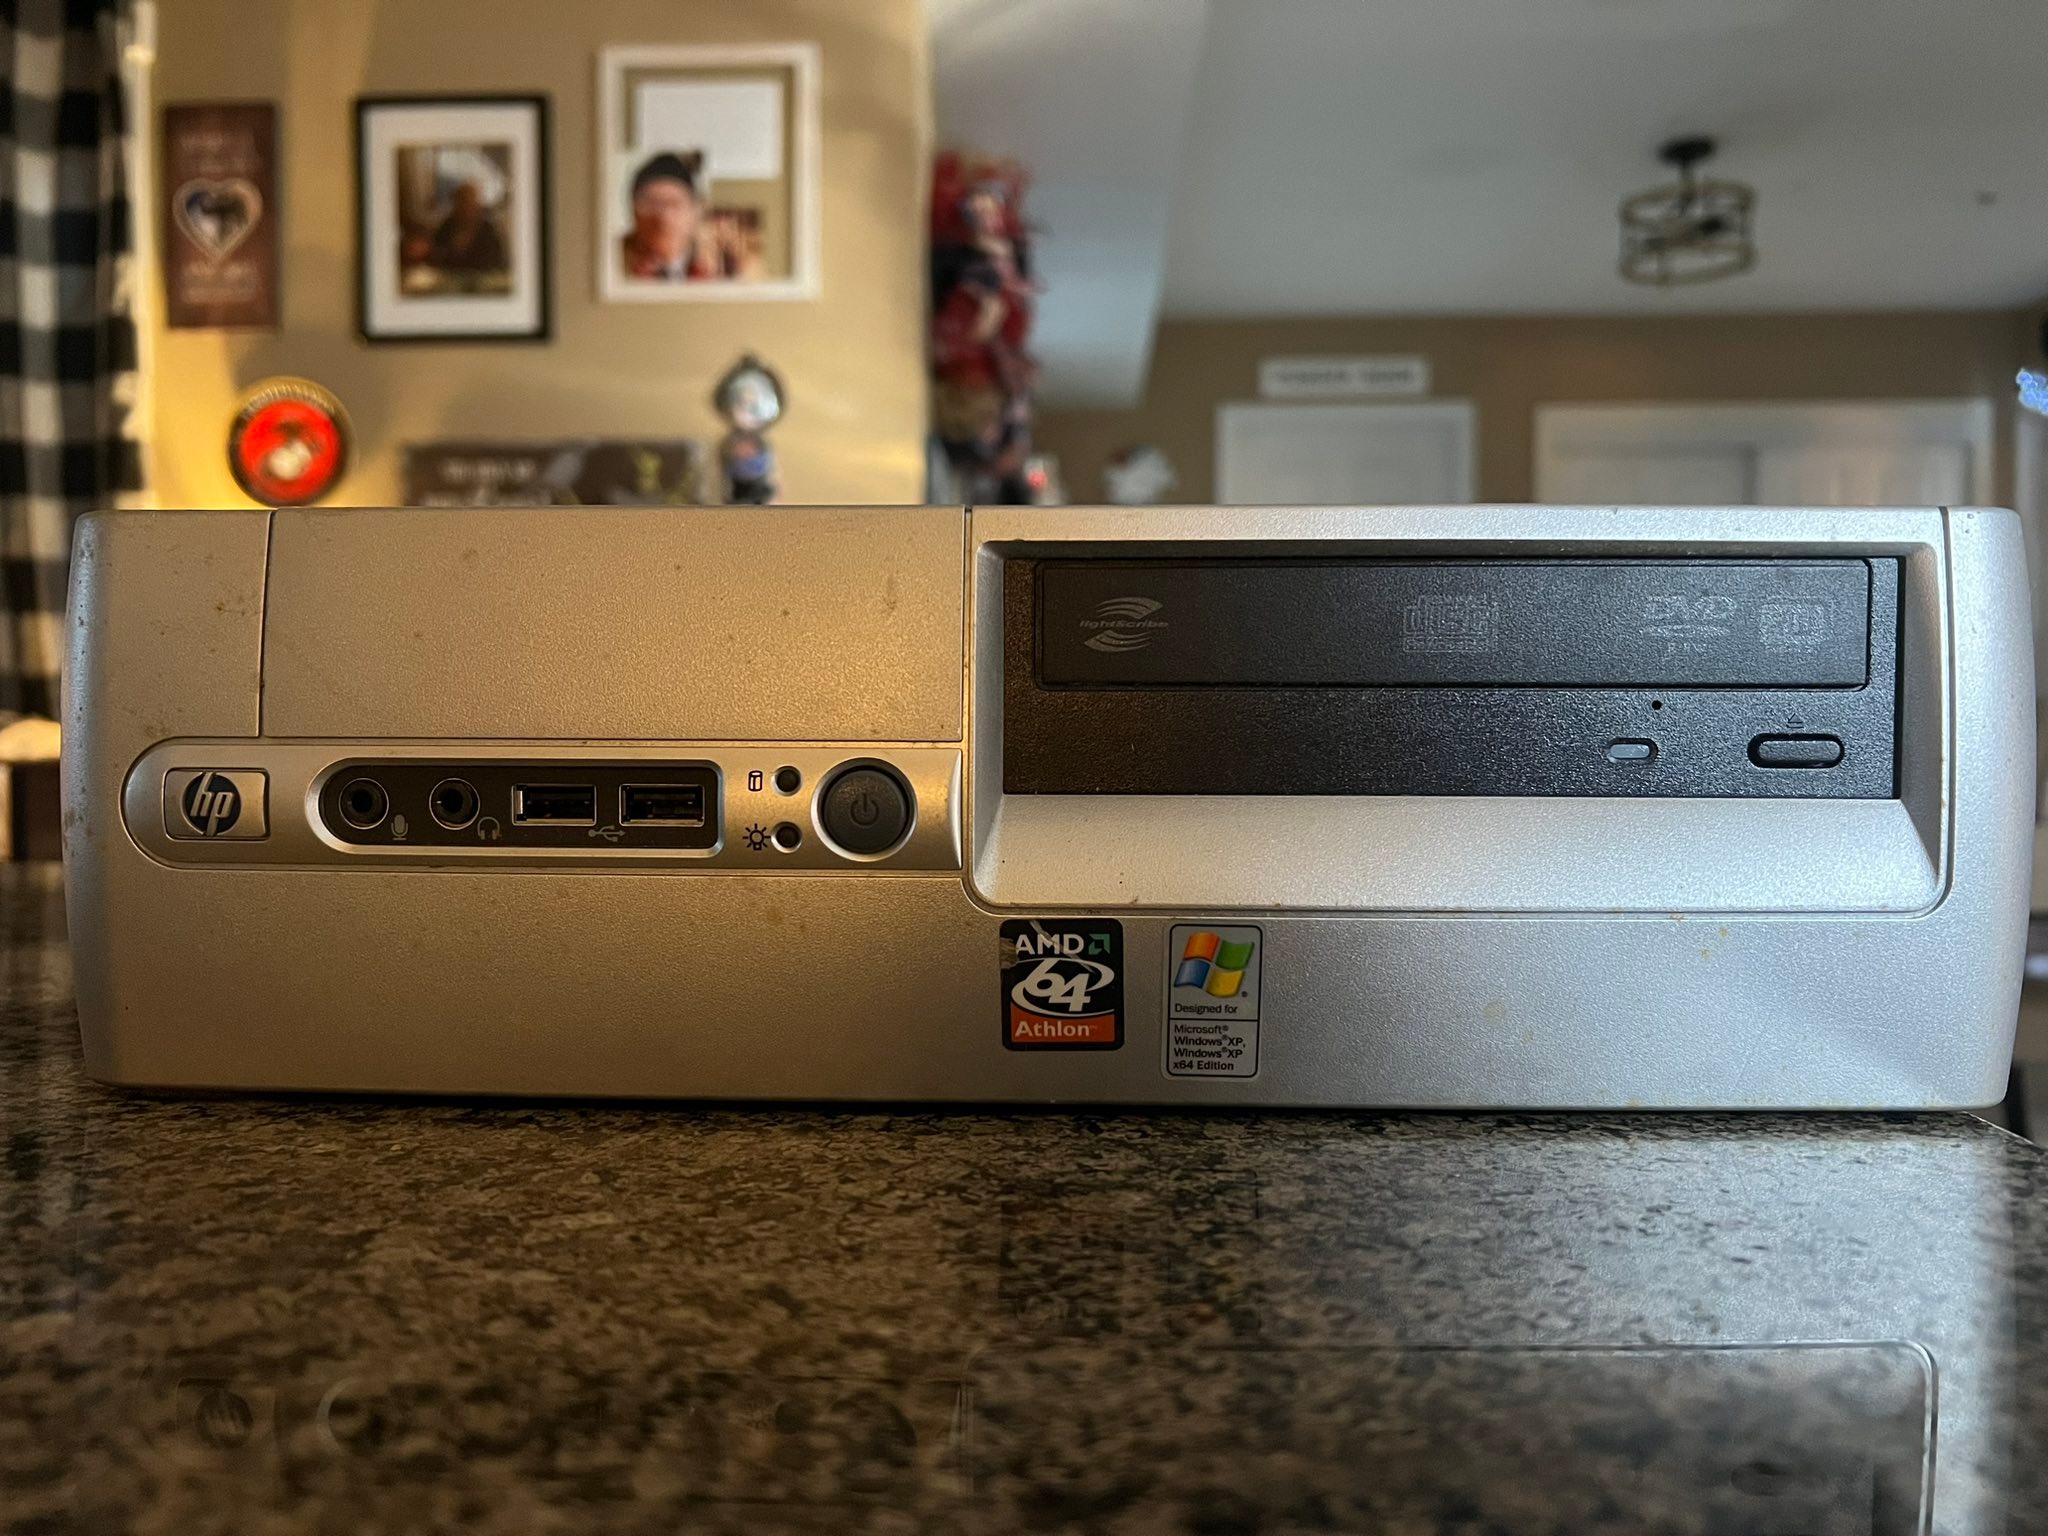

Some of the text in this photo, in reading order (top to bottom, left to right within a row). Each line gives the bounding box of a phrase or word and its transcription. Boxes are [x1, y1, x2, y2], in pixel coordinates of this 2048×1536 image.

[190, 771, 234, 836] hp
[1015, 933, 1085, 955] AMD
[1022, 958, 1091, 1012] 64
[1174, 1003, 1238, 1014] Designed for
[1173, 1060, 1235, 1070] x64 Edition
